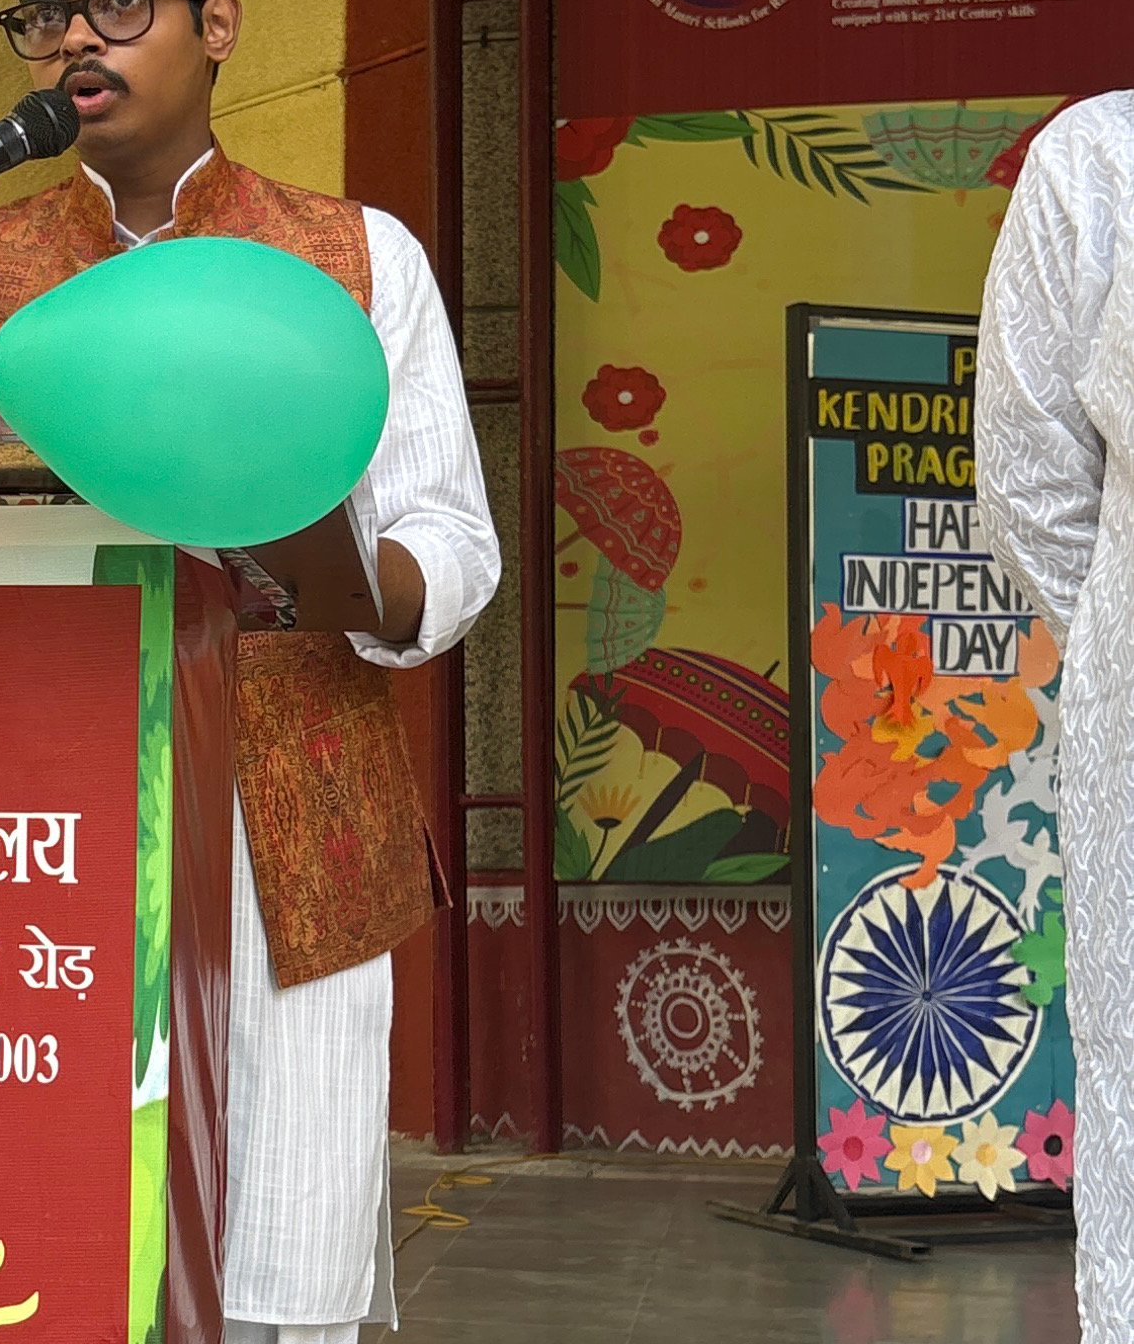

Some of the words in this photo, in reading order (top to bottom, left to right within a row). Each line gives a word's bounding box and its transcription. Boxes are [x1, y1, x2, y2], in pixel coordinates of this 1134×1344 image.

[866, 441, 975, 487] PRAG
[936, 621, 1015, 671] DAY
[18, 925, 96, 1001] रोड़
